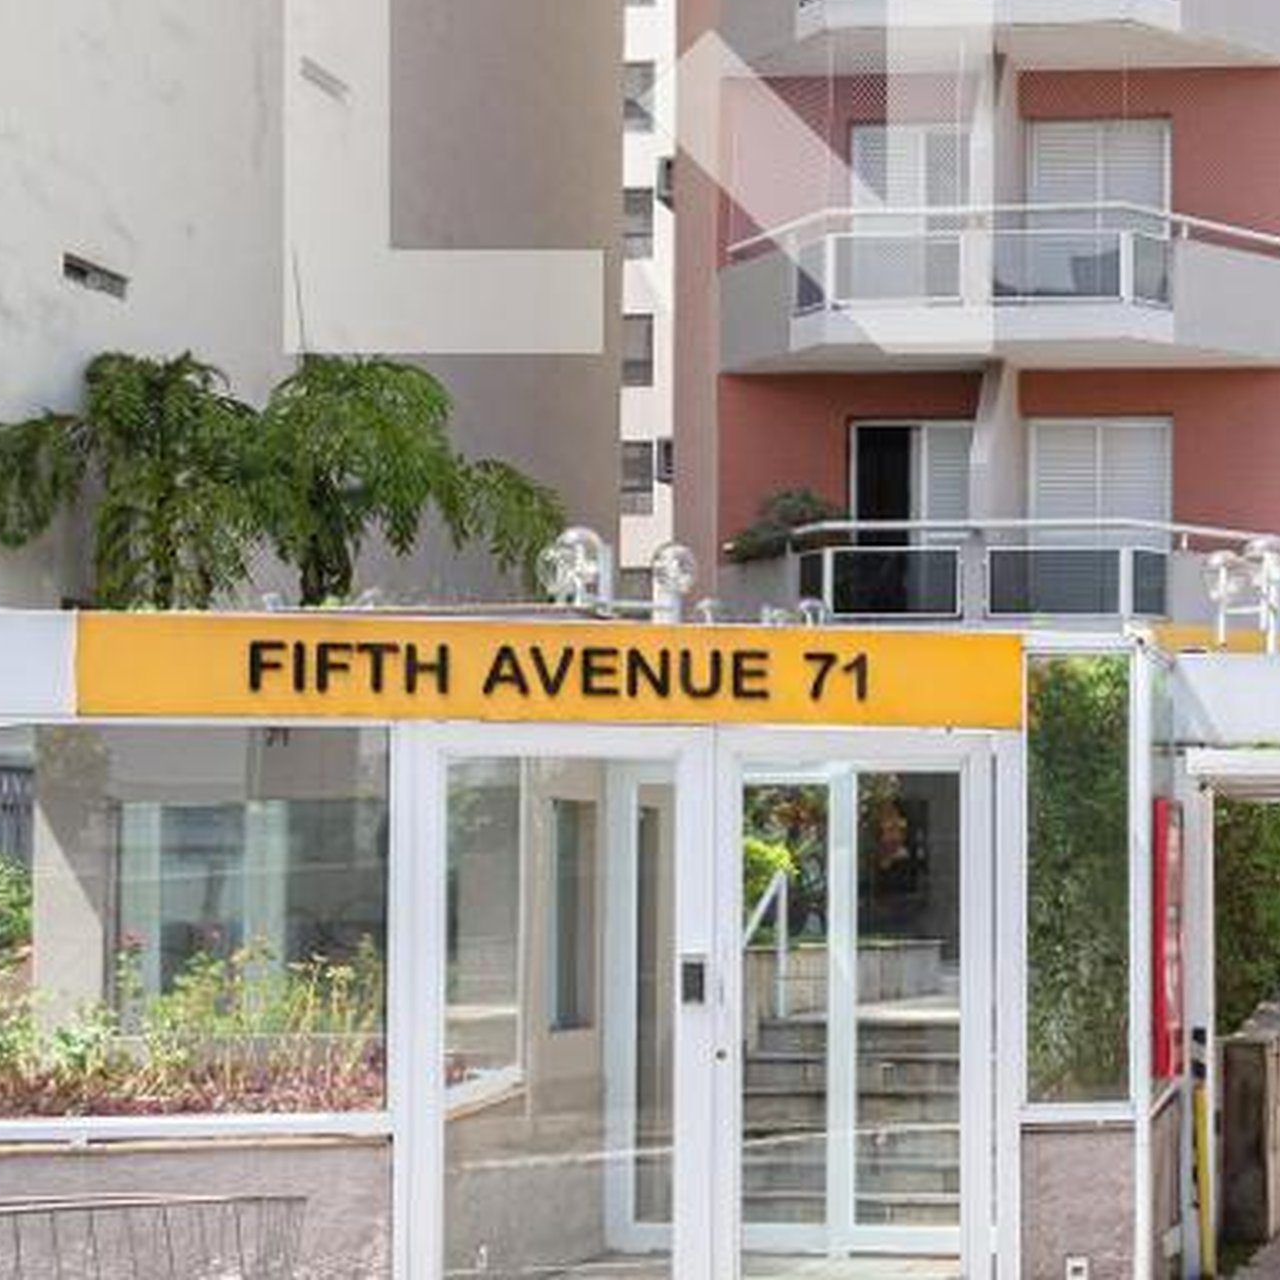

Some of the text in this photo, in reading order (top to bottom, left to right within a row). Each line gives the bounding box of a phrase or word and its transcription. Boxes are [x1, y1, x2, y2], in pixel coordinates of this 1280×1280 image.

[248, 640, 869, 701] FIFTH AVENUE 71
